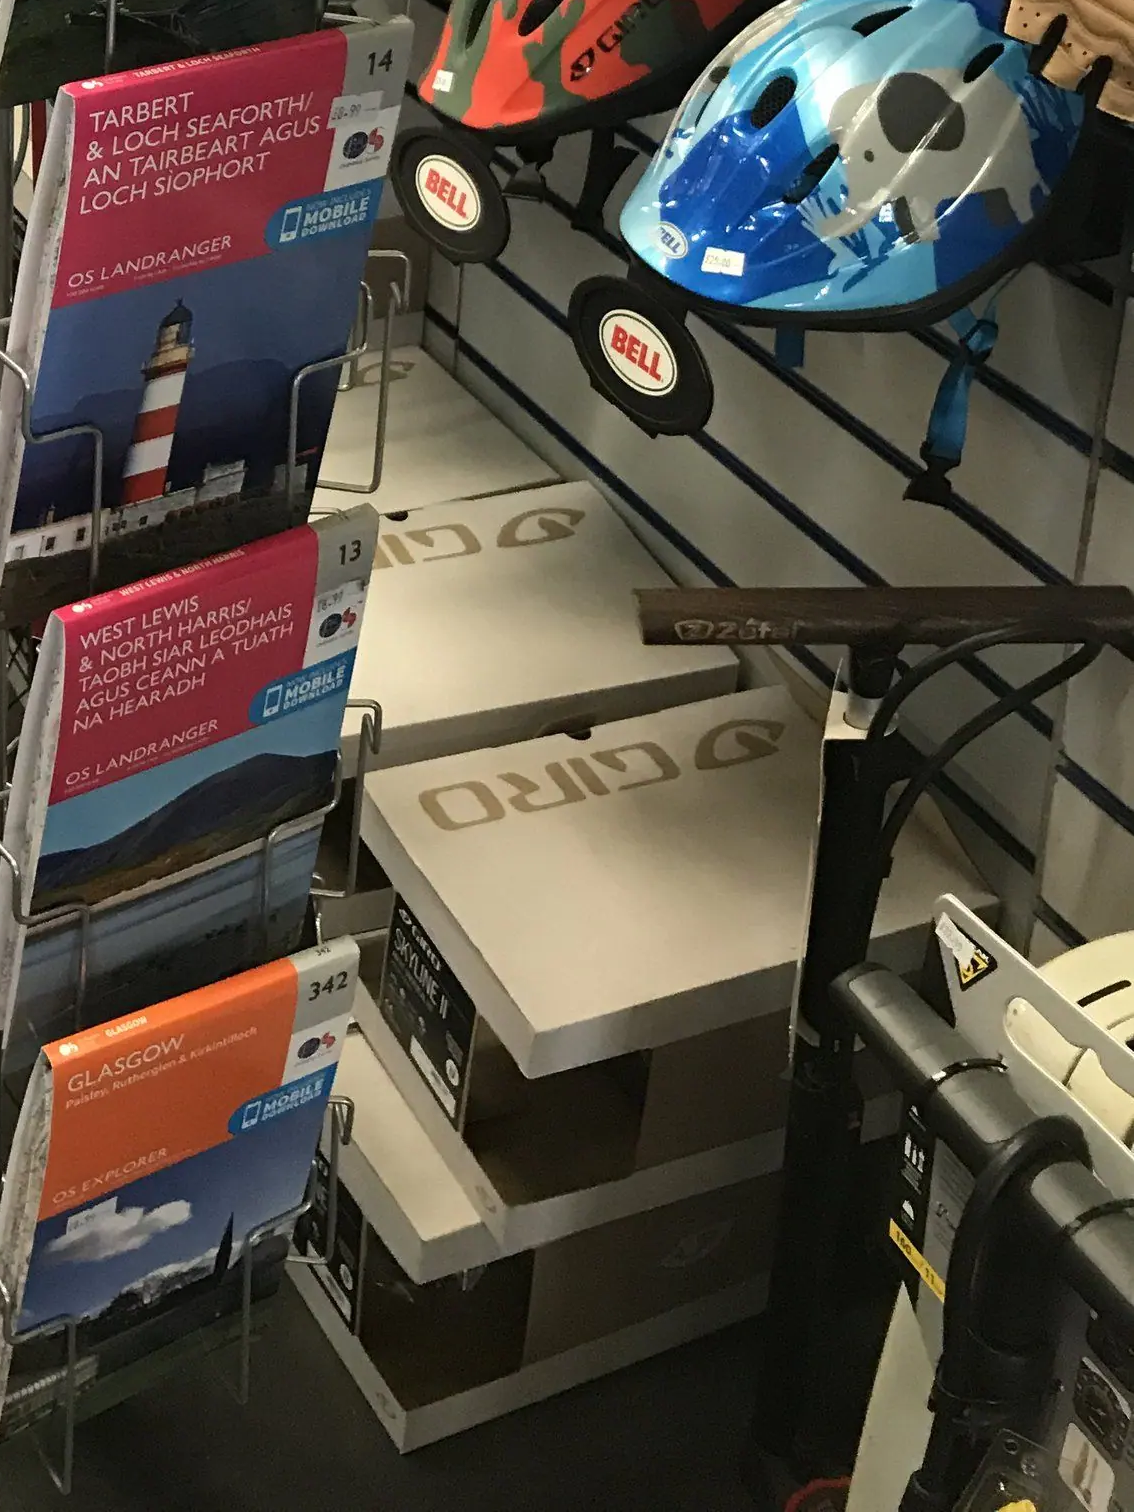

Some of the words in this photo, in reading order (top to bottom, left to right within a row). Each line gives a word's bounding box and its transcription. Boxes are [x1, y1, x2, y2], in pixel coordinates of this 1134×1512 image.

[368, 48, 393, 76] 14
[86, 141, 104, 162] &
[112, 125, 180, 156] LOCH
[186, 91, 314, 139] SEAFORTH/
[89, 91, 194, 133] TARBERT
[82, 162, 121, 190] AN
[128, 130, 253, 178] TAIRBEART
[259, 115, 321, 149] AGUS
[79, 183, 146, 217] LOCH
[303, 197, 370, 227] MOBILE
[426, 168, 471, 220] BELL
[301, 212, 367, 237] DOWNLOAD
[68, 268, 94, 289] OS
[101, 235, 232, 281] LANDRANGER
[609, 326, 663, 384] BELL
[337, 538, 362, 566] 13
[78, 656, 147, 693] TAOBH
[152, 641, 193, 673] SIAR
[199, 603, 293, 649] LEODHAIS
[79, 656, 92, 673] &
[100, 629, 172, 666] NORTH
[178, 597, 252, 641] HARRIS/
[80, 616, 136, 650] WEST
[141, 595, 199, 630] LEWIS
[74, 681, 130, 714] AGUS
[136, 653, 206, 694] CEANN
[210, 648, 225, 665] A
[230, 622, 293, 657] TUATH
[284, 664, 345, 702] MOBILE
[72, 714, 103, 735] NA
[109, 673, 206, 722] HEARADH
[65, 767, 91, 786] OS
[96, 719, 219, 777] LANDRANGER
[419, 740, 682, 831] GIRO
[308, 971, 349, 1002] 342
[394, 928, 439, 1006] SKYLINE
[105, 1015, 148, 1038] GLASGOW
[67, 1033, 185, 1092] GLASGOW
[263, 1078, 325, 1114] MOBILE
[52, 1186, 76, 1204] OS
[81, 1147, 168, 1192] EXPLORER
